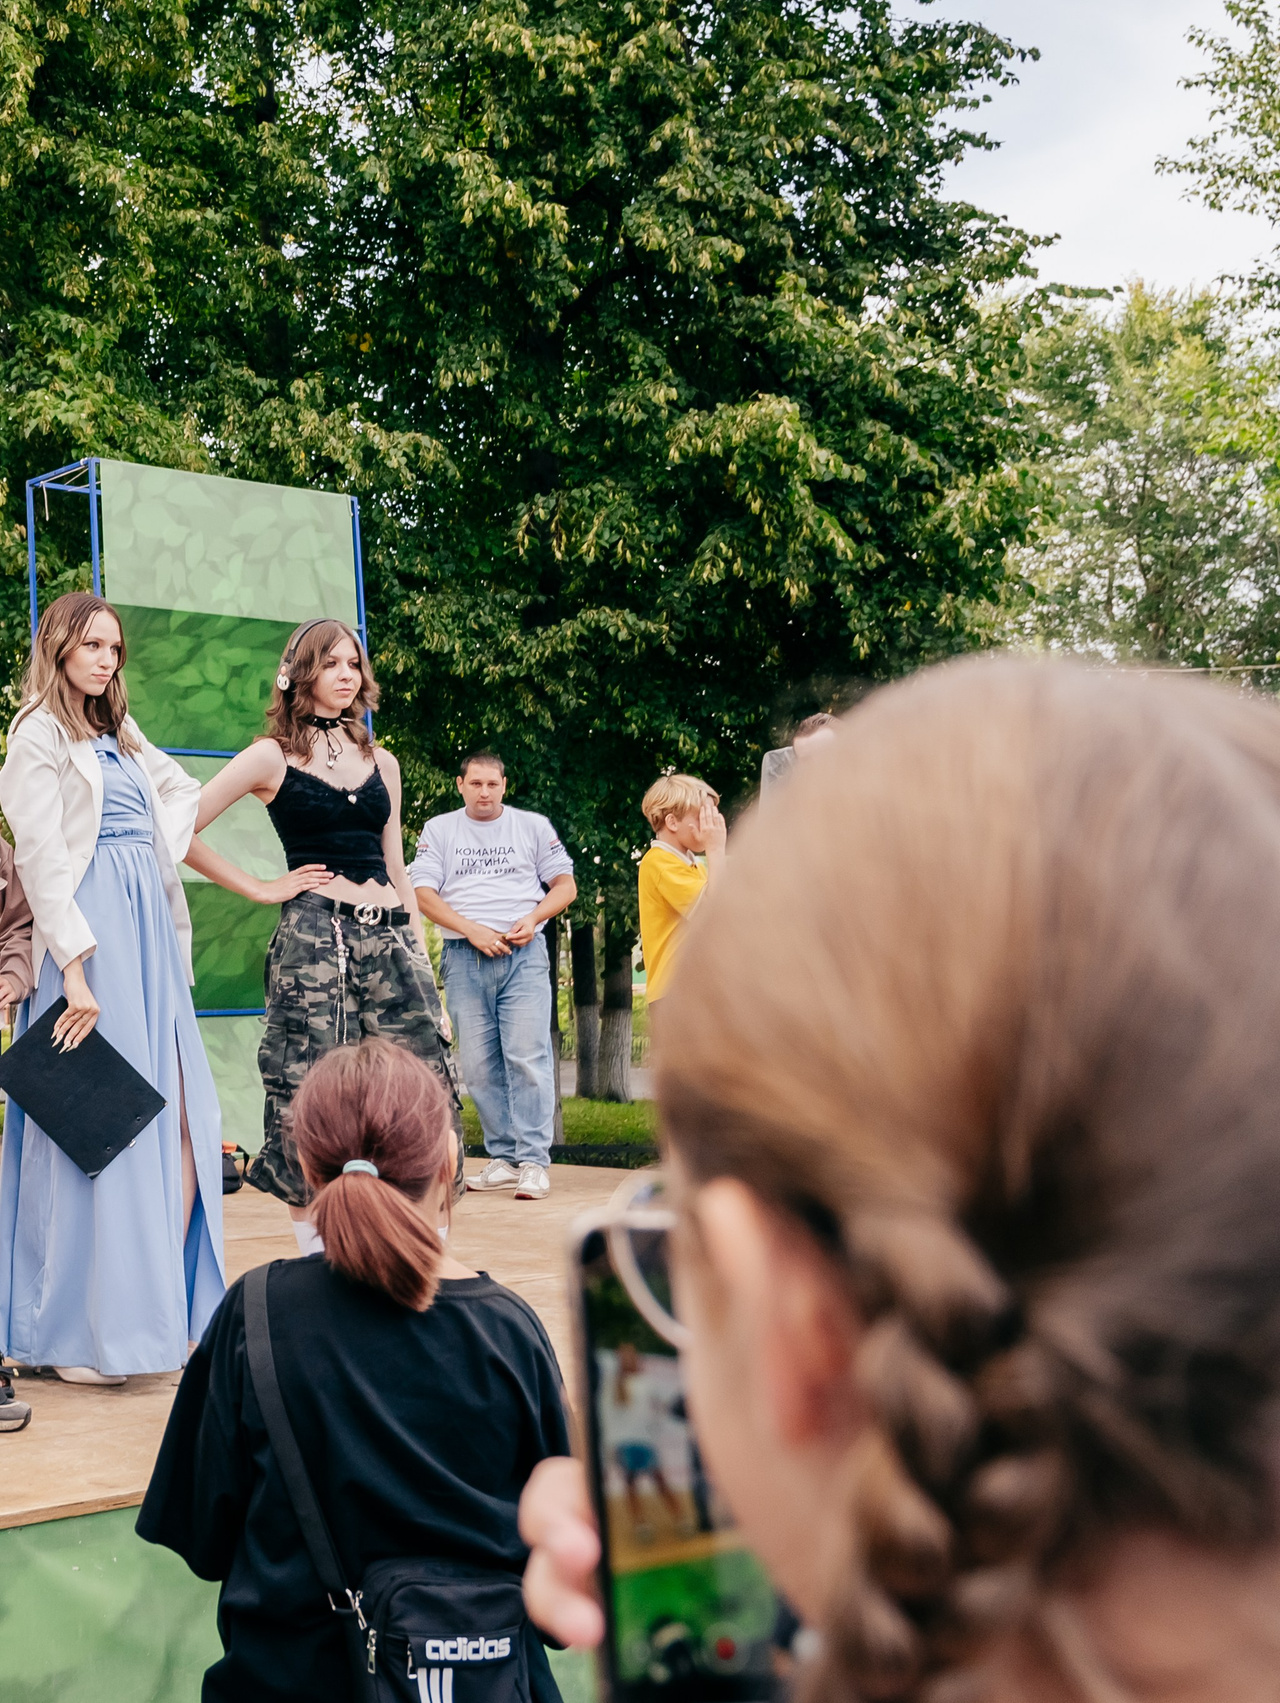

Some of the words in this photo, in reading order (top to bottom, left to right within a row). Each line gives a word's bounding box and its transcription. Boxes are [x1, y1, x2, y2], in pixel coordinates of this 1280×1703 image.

[455, 846, 516, 857] КОМАНДА
[461, 857, 510, 866] ПУТИНА
[426, 1637, 511, 1661] adidas
